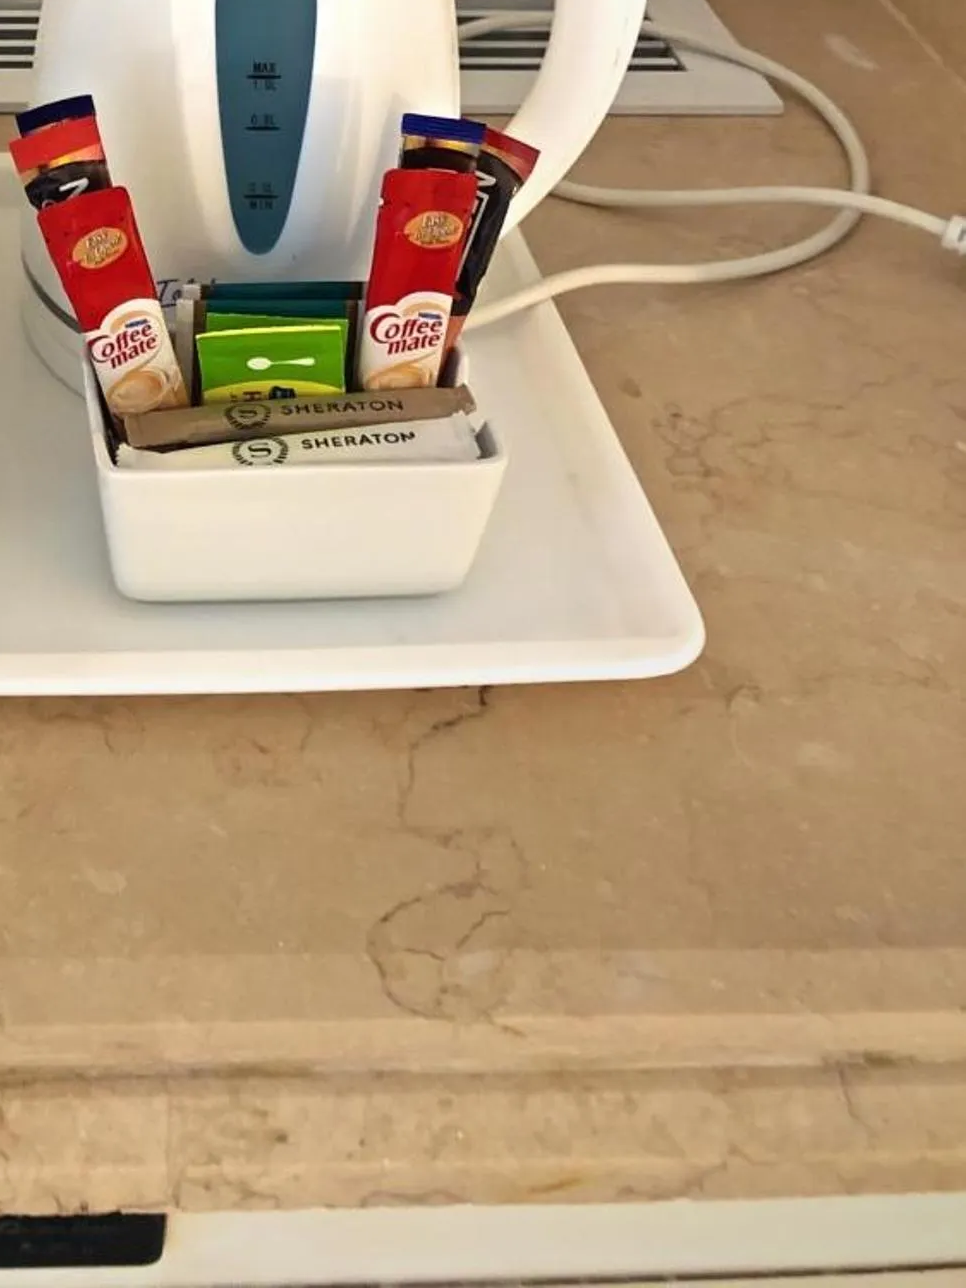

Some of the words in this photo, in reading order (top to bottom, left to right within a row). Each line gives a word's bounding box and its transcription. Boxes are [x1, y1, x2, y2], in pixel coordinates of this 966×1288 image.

[253, 61, 277, 73] MAX
[369, 312, 443, 344] Coffee
[87, 324, 152, 364] Coffee
[110, 336, 157, 369] mate
[387, 334, 441, 355] mate
[280, 399, 404, 417] SHERATON
[301, 430, 416, 450] SHERATON
